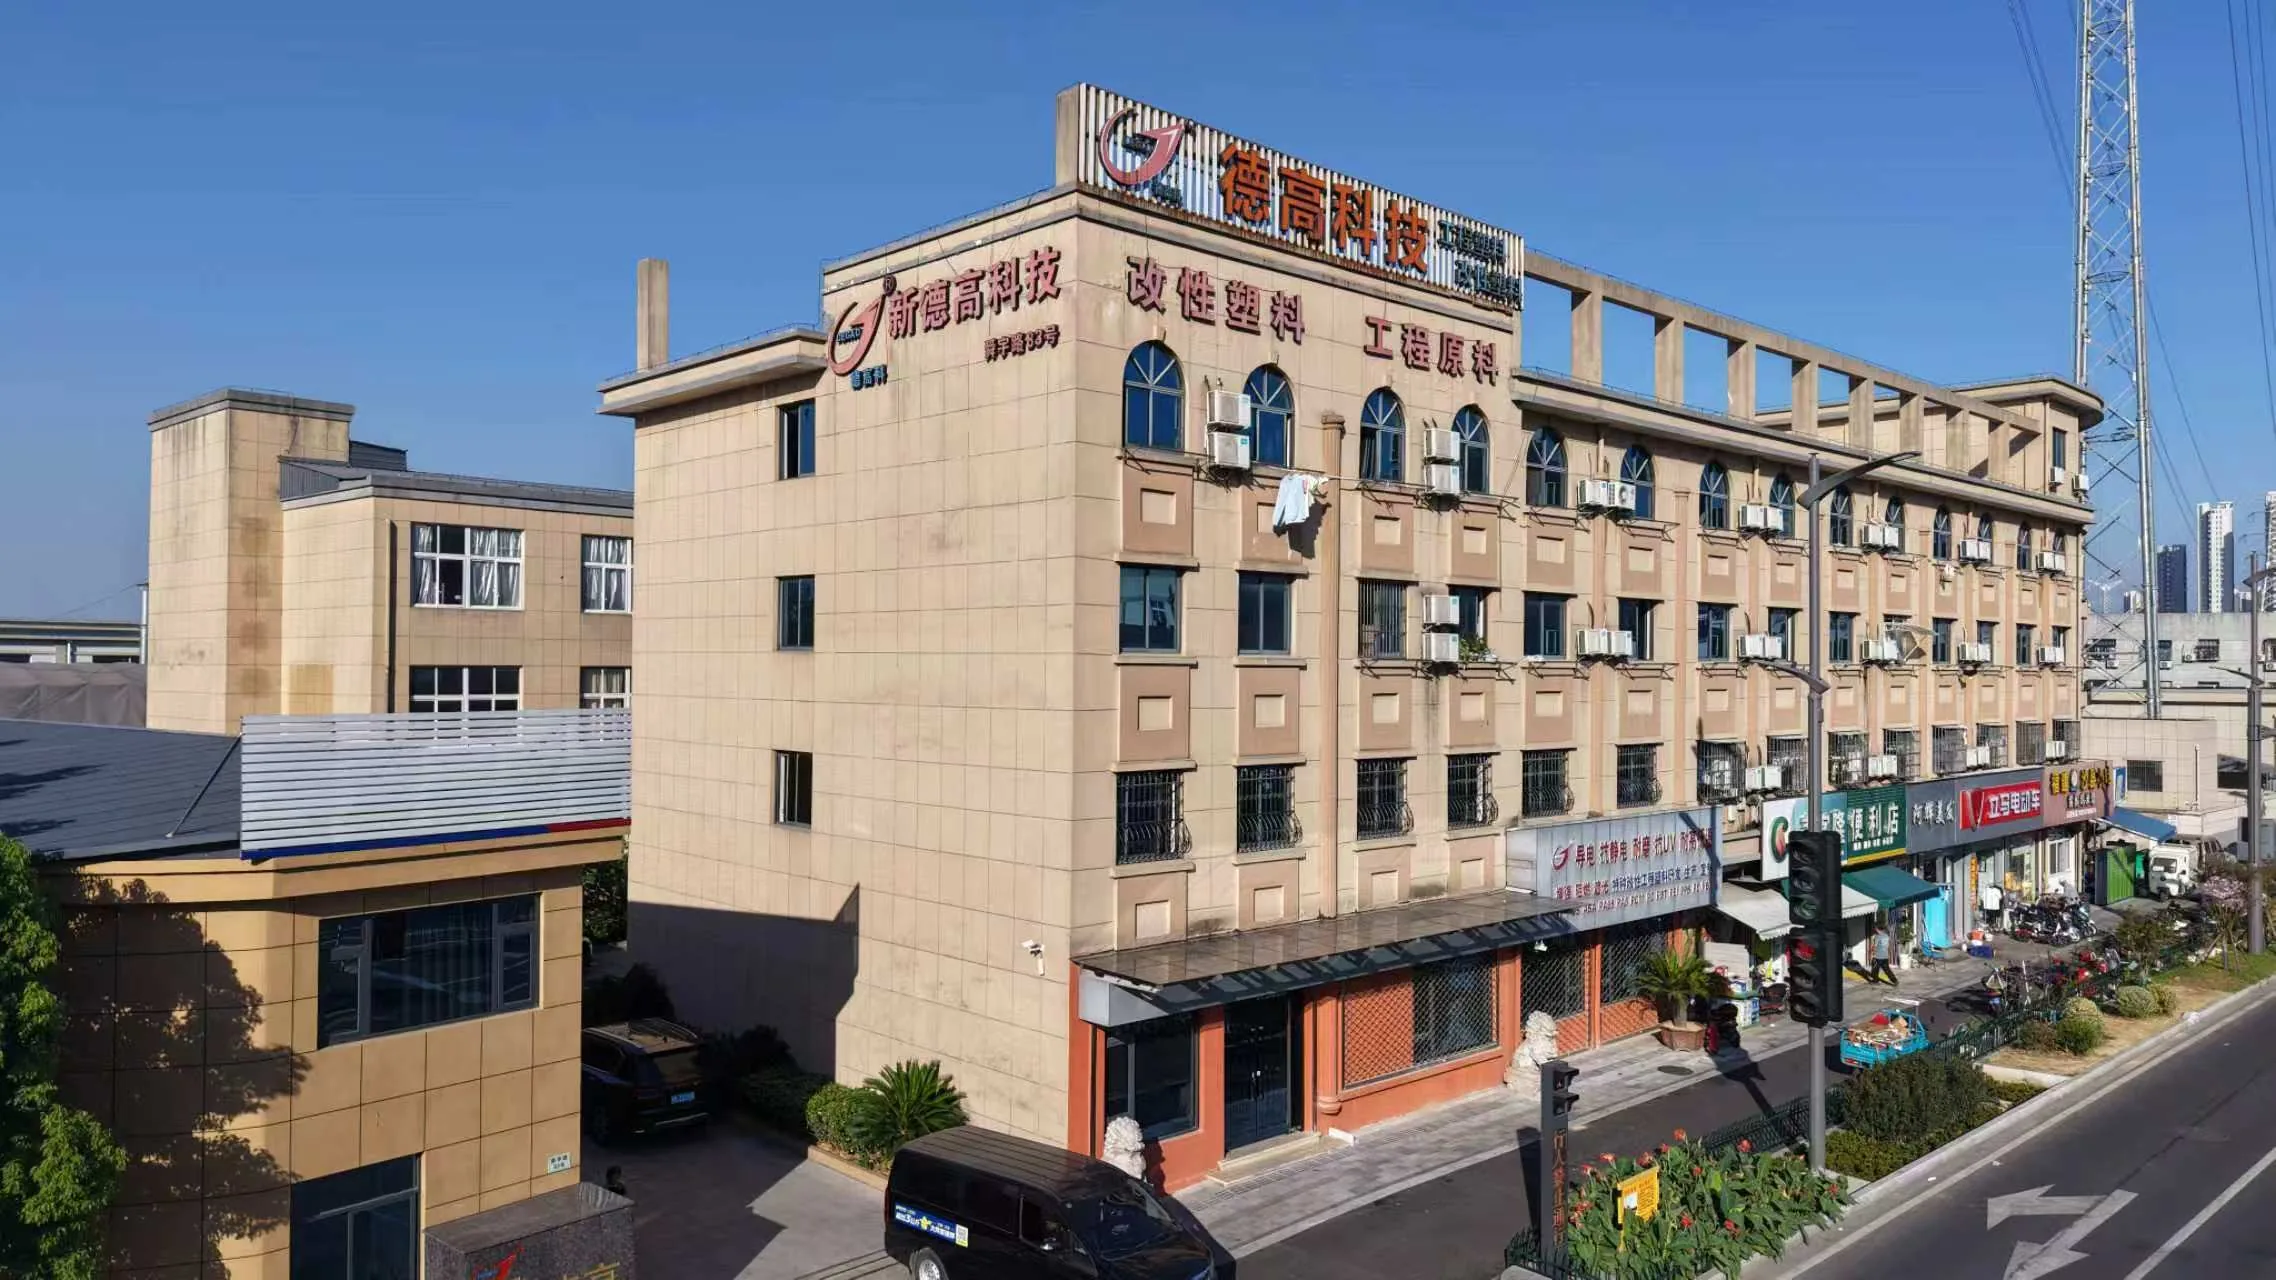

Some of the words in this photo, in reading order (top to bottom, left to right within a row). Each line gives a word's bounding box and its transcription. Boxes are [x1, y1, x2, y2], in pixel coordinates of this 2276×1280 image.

[1219, 143, 1428, 273] 德高科技
[888, 246, 1061, 340] 新德高科技
[1126, 255, 1306, 345] 改性塑料
[1364, 315, 1500, 386] 工程原料
[1799, 801, 1899, 843] 隆便利店
[1988, 789, 2040, 819] 立马电动车
[1576, 842, 1595, 868] 导电
[1600, 837, 1628, 865] 抗静电
